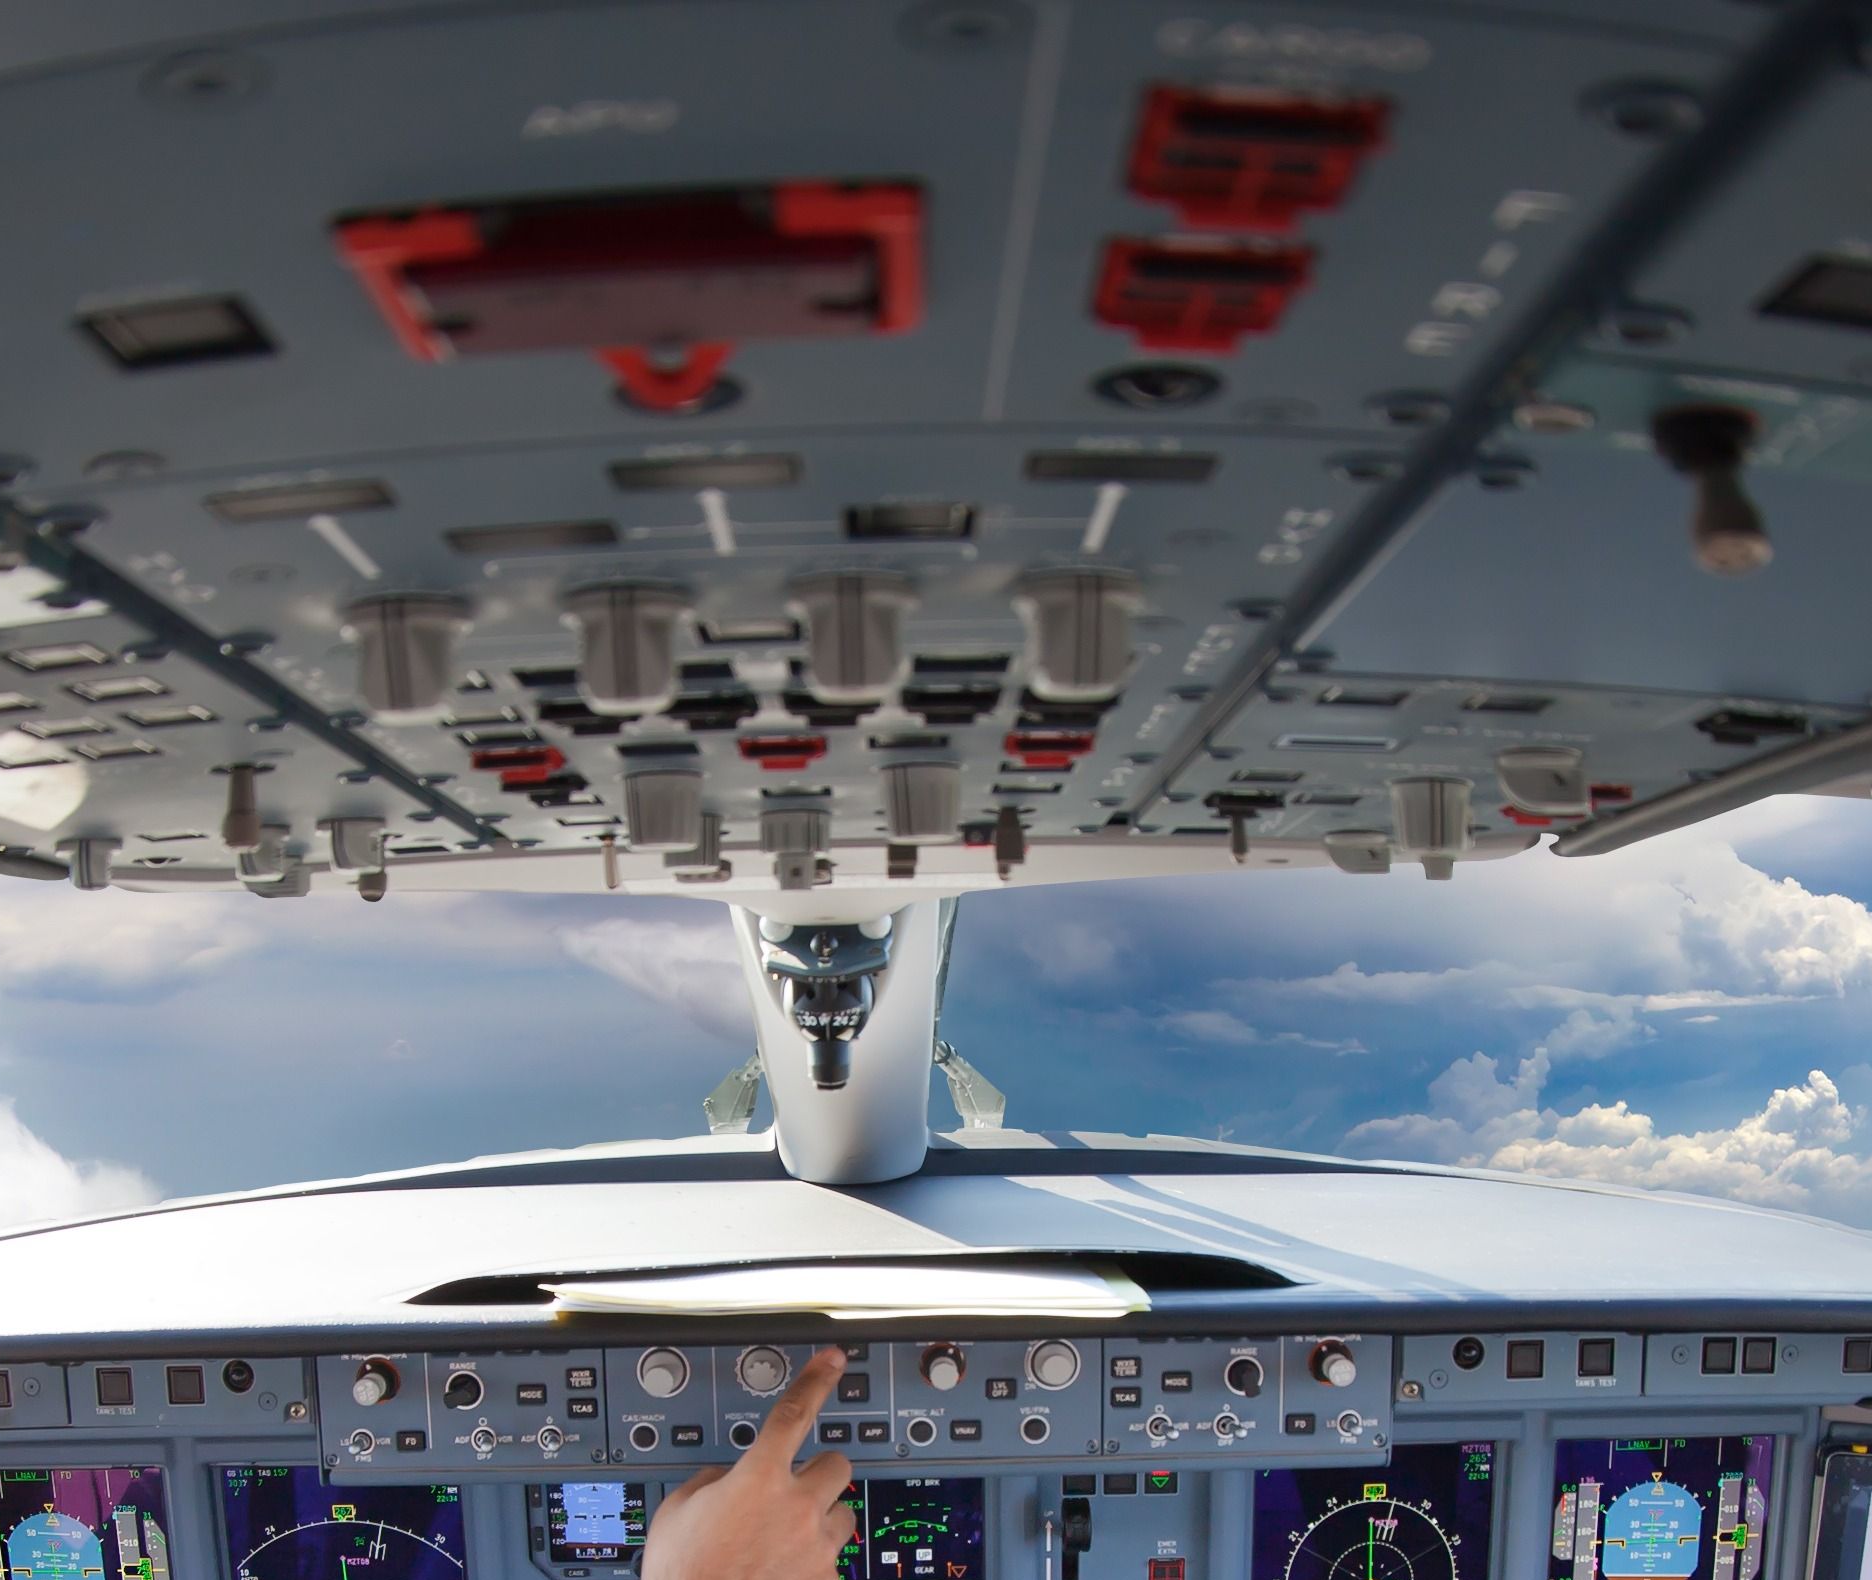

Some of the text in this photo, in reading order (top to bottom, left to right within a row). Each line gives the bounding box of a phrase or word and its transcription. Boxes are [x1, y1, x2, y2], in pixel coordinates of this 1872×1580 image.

[449, 1362, 476, 1370] RANGE
[1165, 1378, 1188, 1386] MODE
[1599, 1378, 1617, 1387] TEST
[1115, 1394, 1136, 1402] TCAS
[119, 1406, 136, 1415] TEST
[572, 1405, 593, 1413] TCAS
[897, 1408, 945, 1417] METRIC ALT
[622, 1414, 666, 1422] CAS/MACH
[1294, 1420, 1306, 1428] FD
[828, 1430, 842, 1438] LOC
[866, 1428, 883, 1437] APP
[955, 1427, 977, 1435] VNAV
[677, 1432, 698, 1440] AUTO
[1151, 1440, 1167, 1448] OFF
[1675, 1440, 1685, 1448] FD
[1742, 1437, 1753, 1445] TO
[1327, 1497, 1338, 1507] 24
[265, 1525, 276, 1535] 24
[434, 1534, 445, 1544] 30
[928, 1535, 933, 1543] 2
[1288, 1530, 1300, 1542] 21
[918, 1551, 930, 1559] UP
[915, 1566, 934, 1574] GEAR
